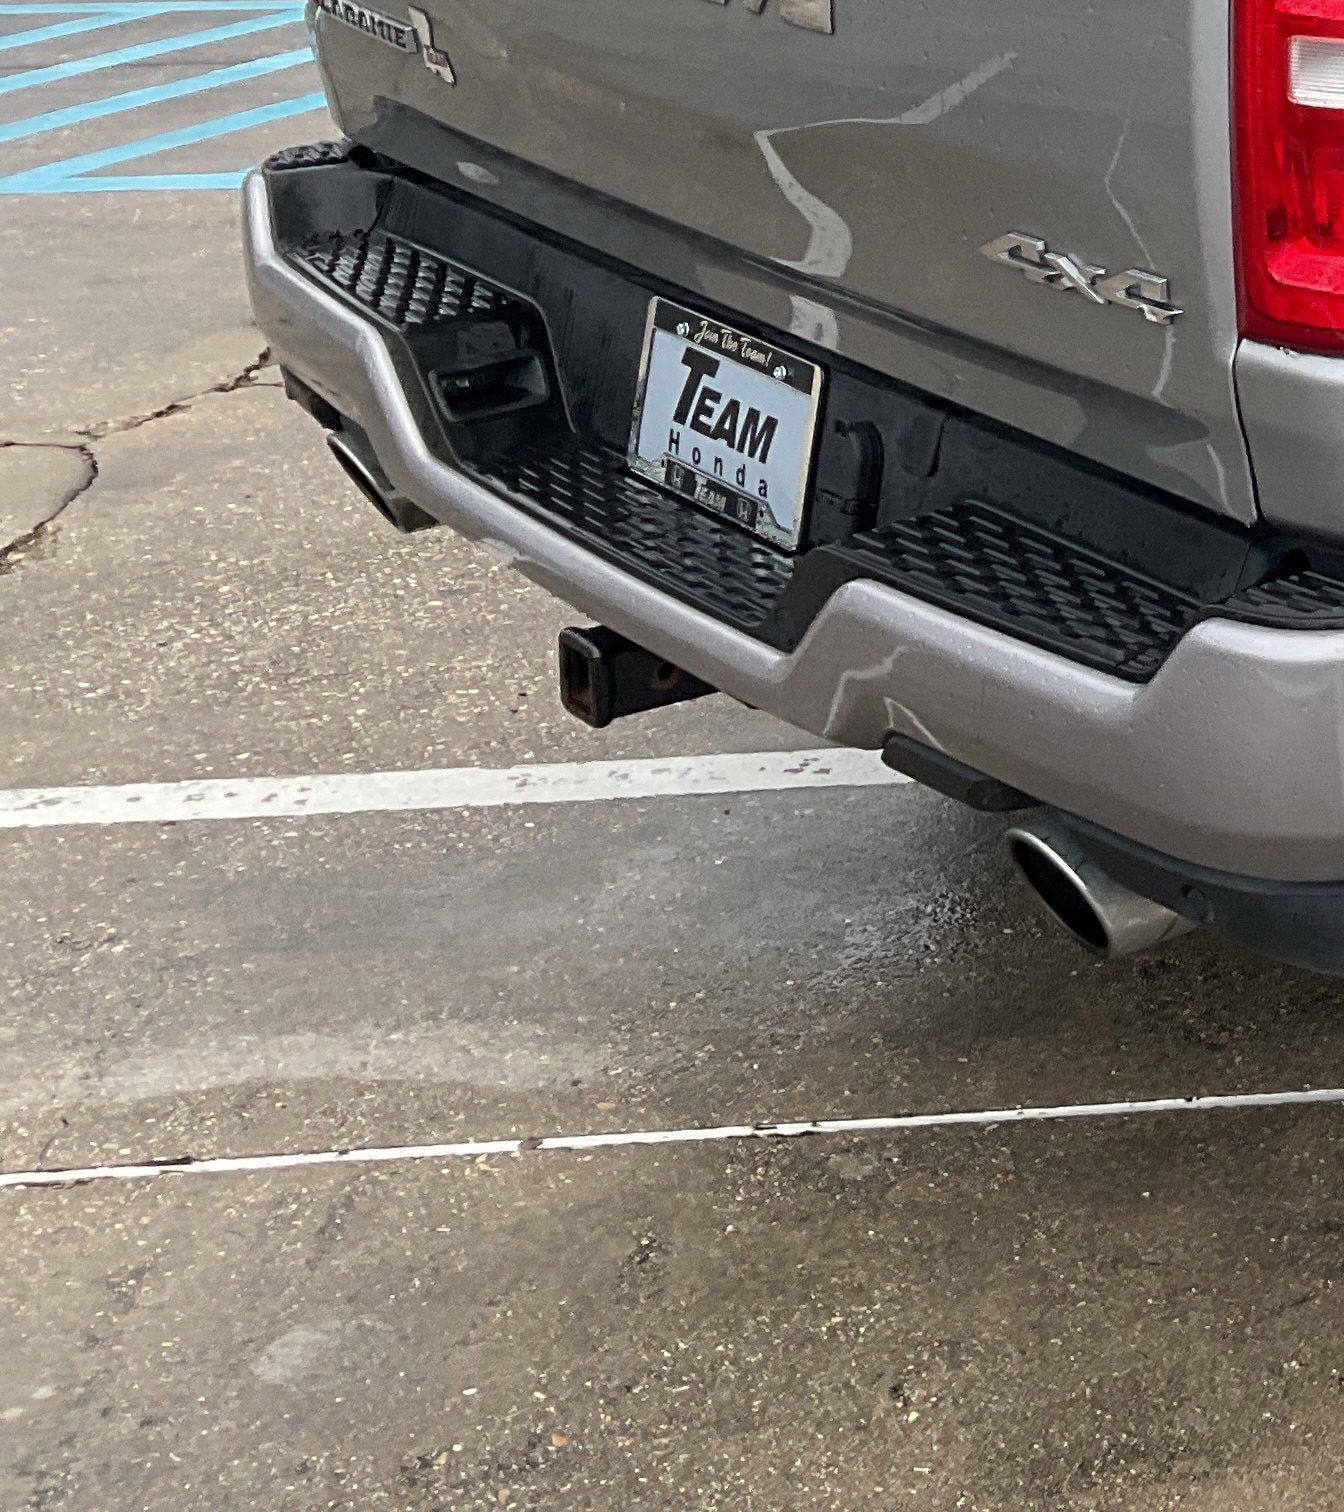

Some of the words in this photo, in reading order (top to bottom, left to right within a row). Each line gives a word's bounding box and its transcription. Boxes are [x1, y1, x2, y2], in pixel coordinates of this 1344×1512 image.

[673, 346, 779, 464] TEAM
[668, 428, 769, 499] Honda
[694, 474, 727, 513] TEAM
